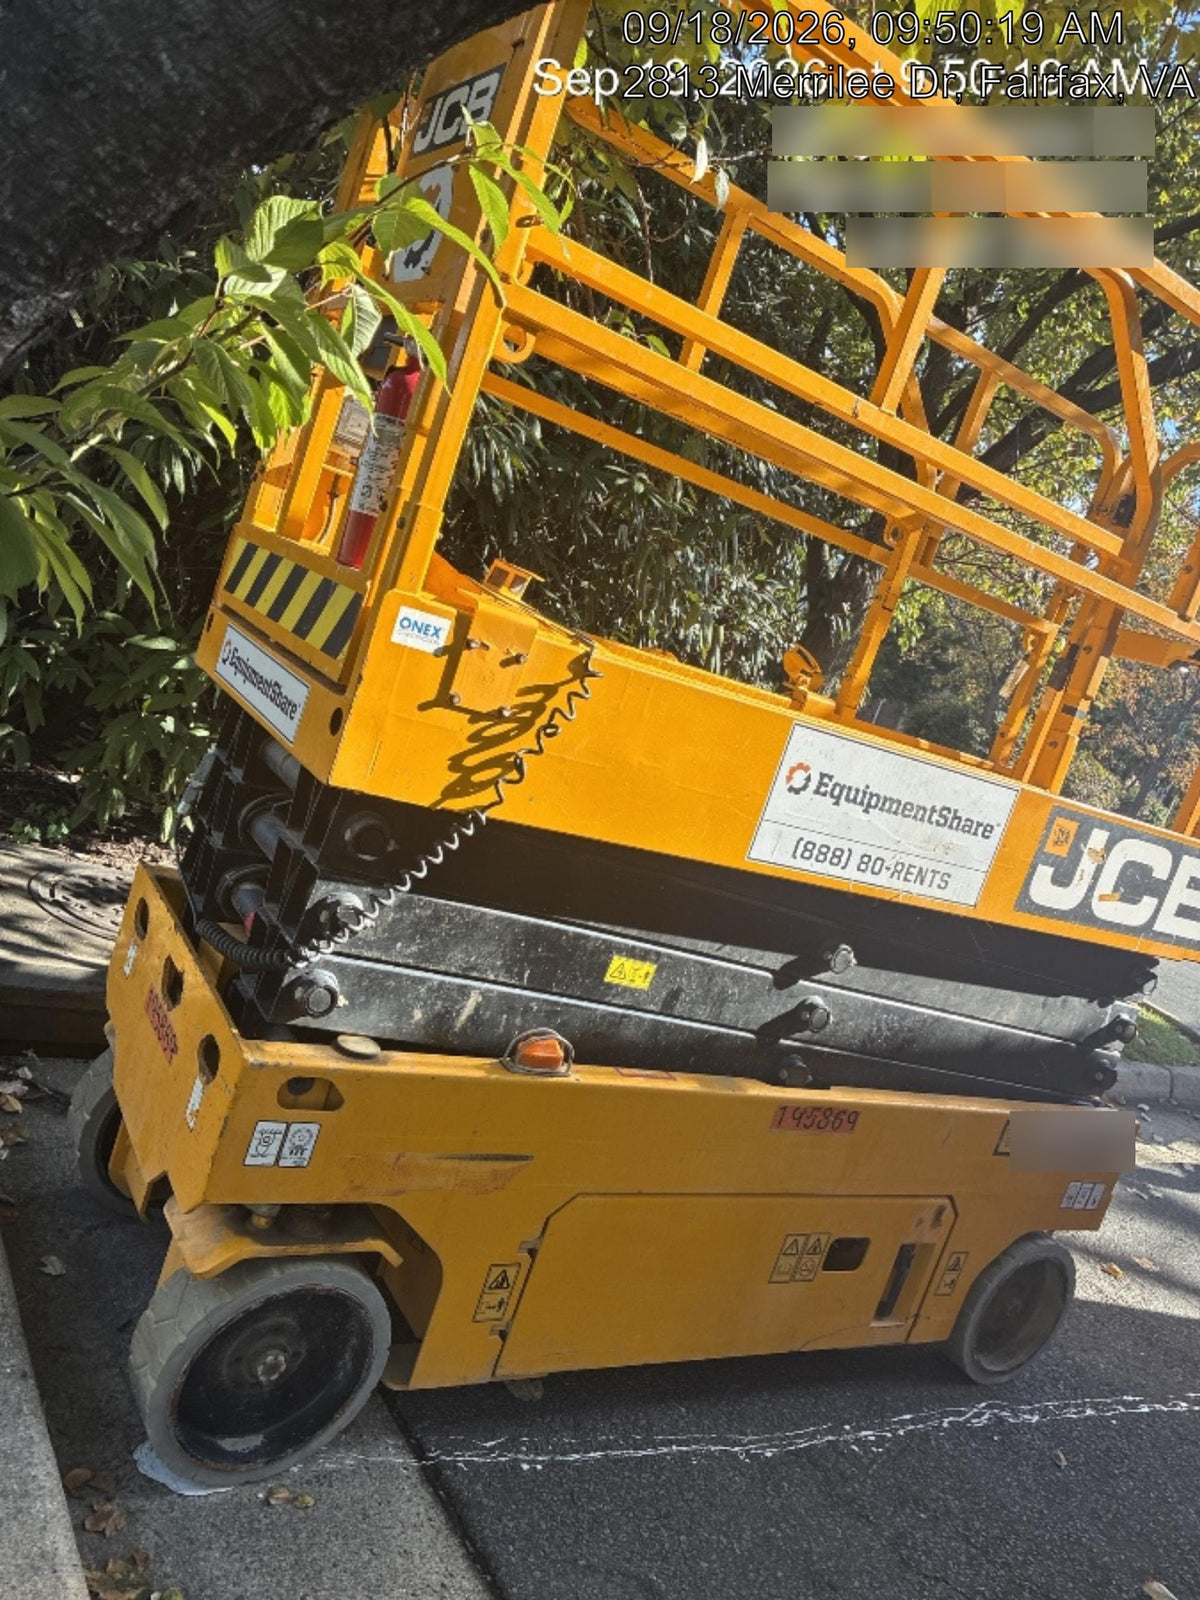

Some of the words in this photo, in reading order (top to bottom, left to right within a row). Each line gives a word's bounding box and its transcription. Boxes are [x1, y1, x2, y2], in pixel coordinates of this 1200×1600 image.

[413, 72, 501, 153] JCB
[399, 616, 442, 639] ONEX
[229, 646, 299, 721] EquipmentShare
[812, 770, 996, 840] EquipmentShare
[791, 836, 852, 870] (888)
[856, 854, 953, 892] 80-RENTS
